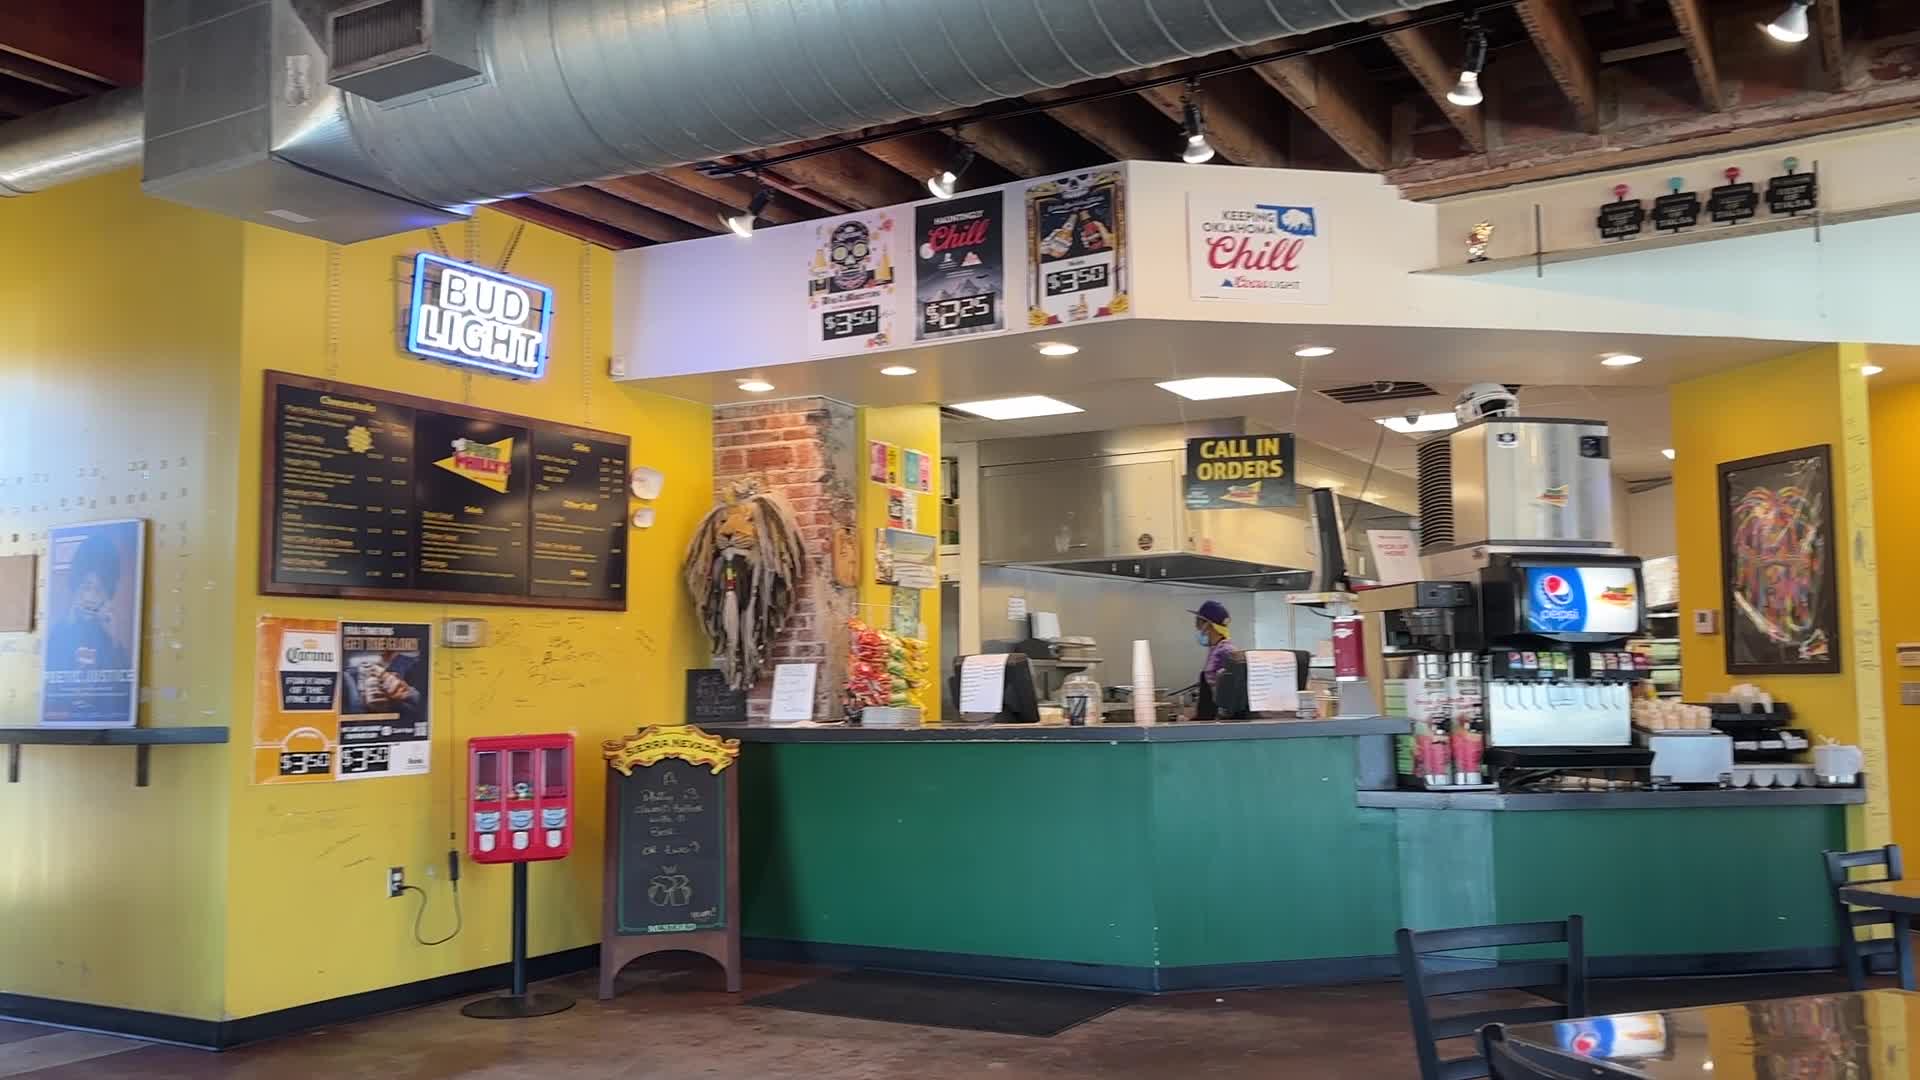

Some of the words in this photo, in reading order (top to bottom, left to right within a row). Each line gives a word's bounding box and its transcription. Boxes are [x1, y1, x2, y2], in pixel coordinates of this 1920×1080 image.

[1223, 210, 1275, 222] KEEPING
[927, 217, 992, 253] Chill
[1202, 222, 1275, 234] OKLAHOMA
[1206, 235, 1304, 272] Chill
[439, 268, 530, 325] BUD
[416, 303, 543, 368] LIGHT
[1199, 439, 1253, 459] CALL
[1256, 437, 1280, 456] IN
[1197, 459, 1284, 481] ORDERS
[1540, 605, 1580, 622] pepsi
[286, 647, 335, 664] Corona
[625, 739, 669, 757] SIERRA
[671, 738, 721, 754] NEVADA
